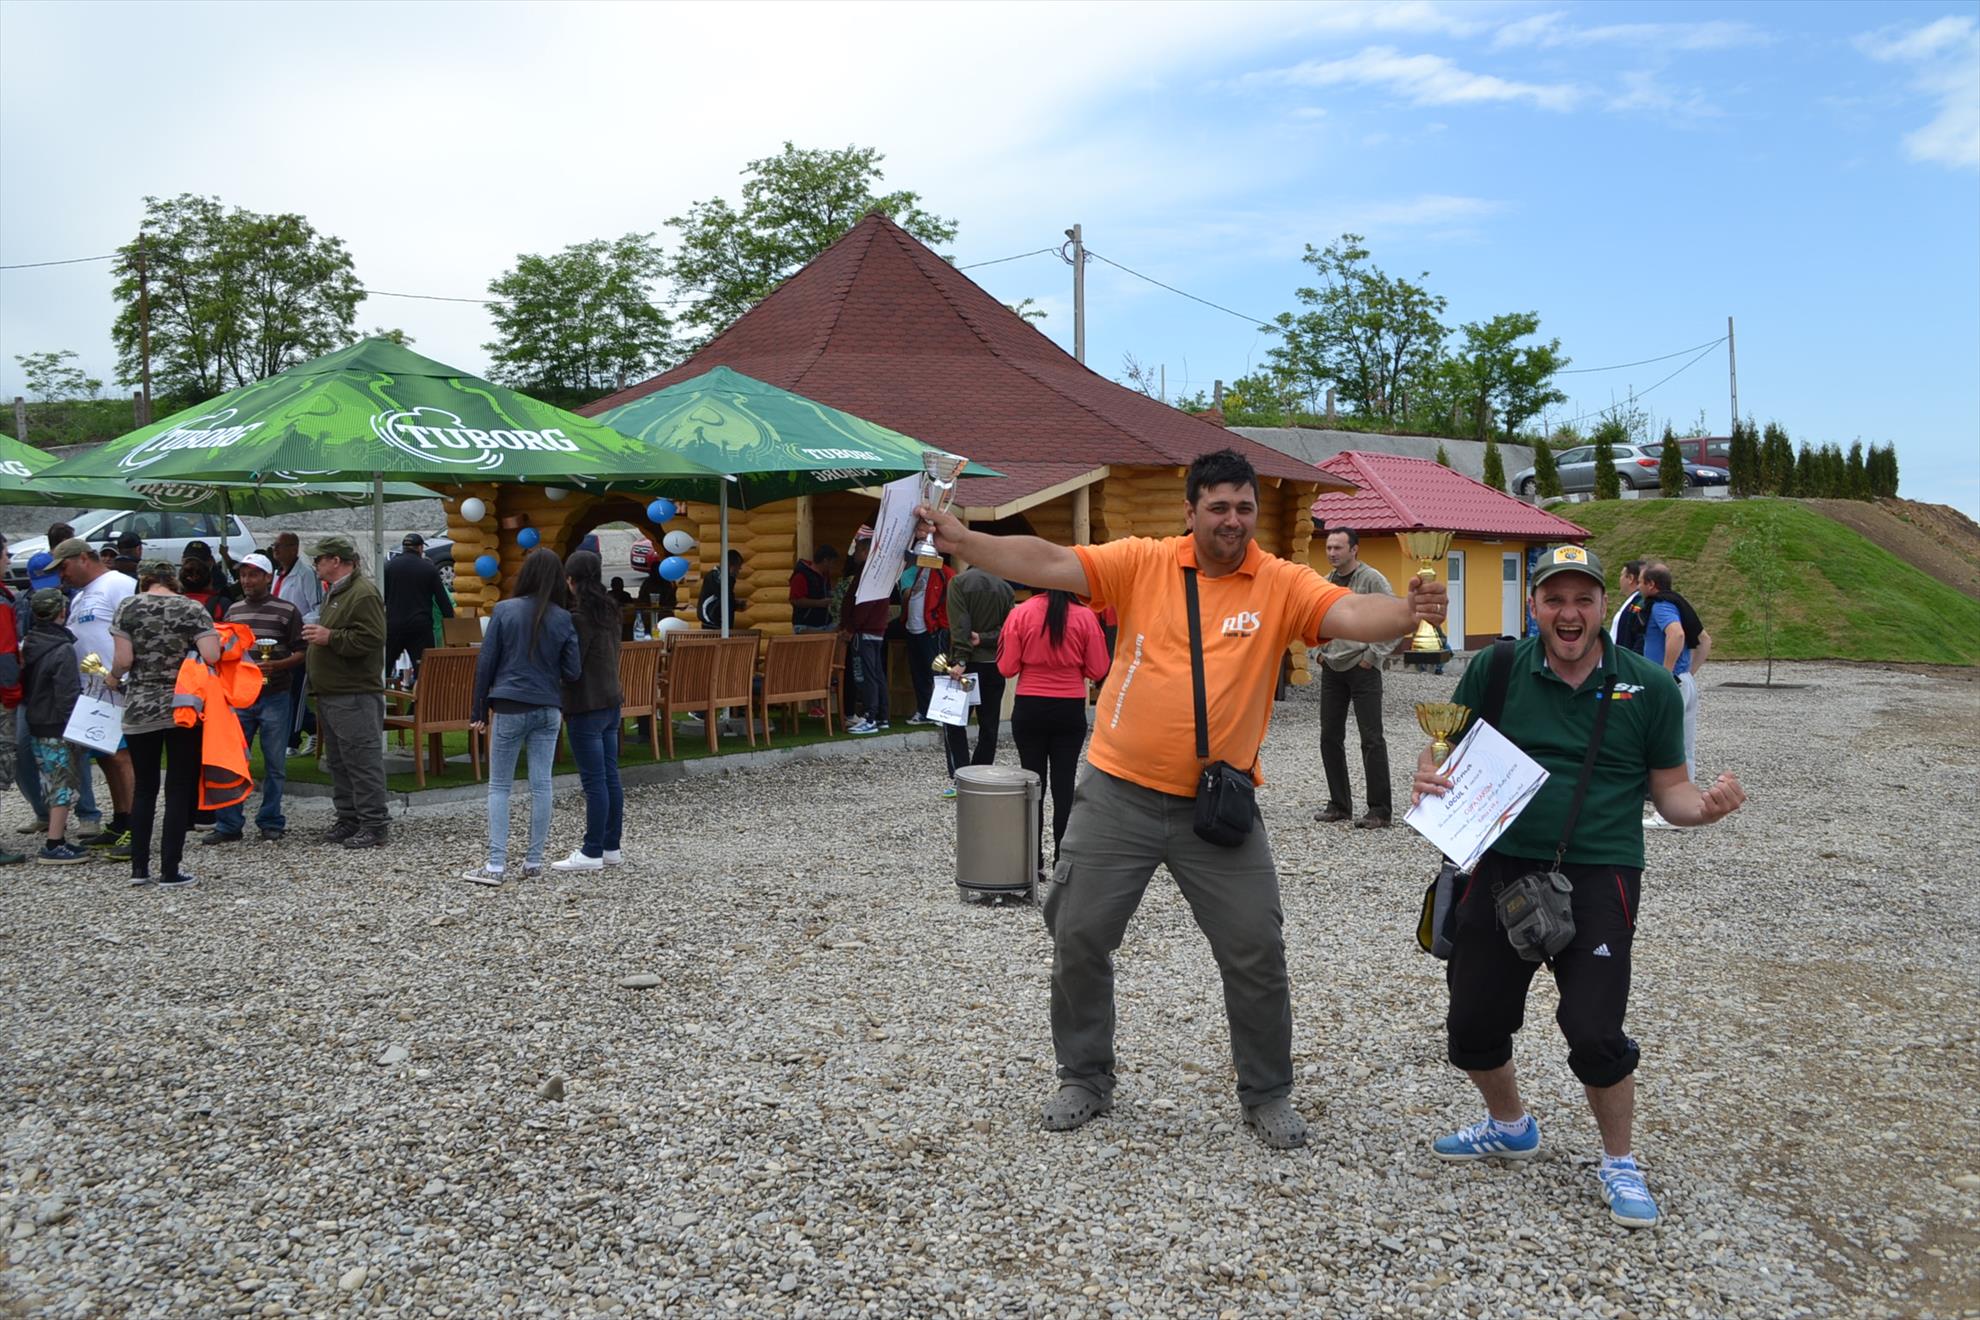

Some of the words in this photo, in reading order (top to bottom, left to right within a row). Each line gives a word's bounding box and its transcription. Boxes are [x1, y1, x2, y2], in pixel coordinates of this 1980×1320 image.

[143, 421, 266, 452] TUBORG
[394, 423, 580, 451] TUBORG
[801, 448, 884, 461] TUBORG
[1445, 790, 1465, 810] LOCUL
